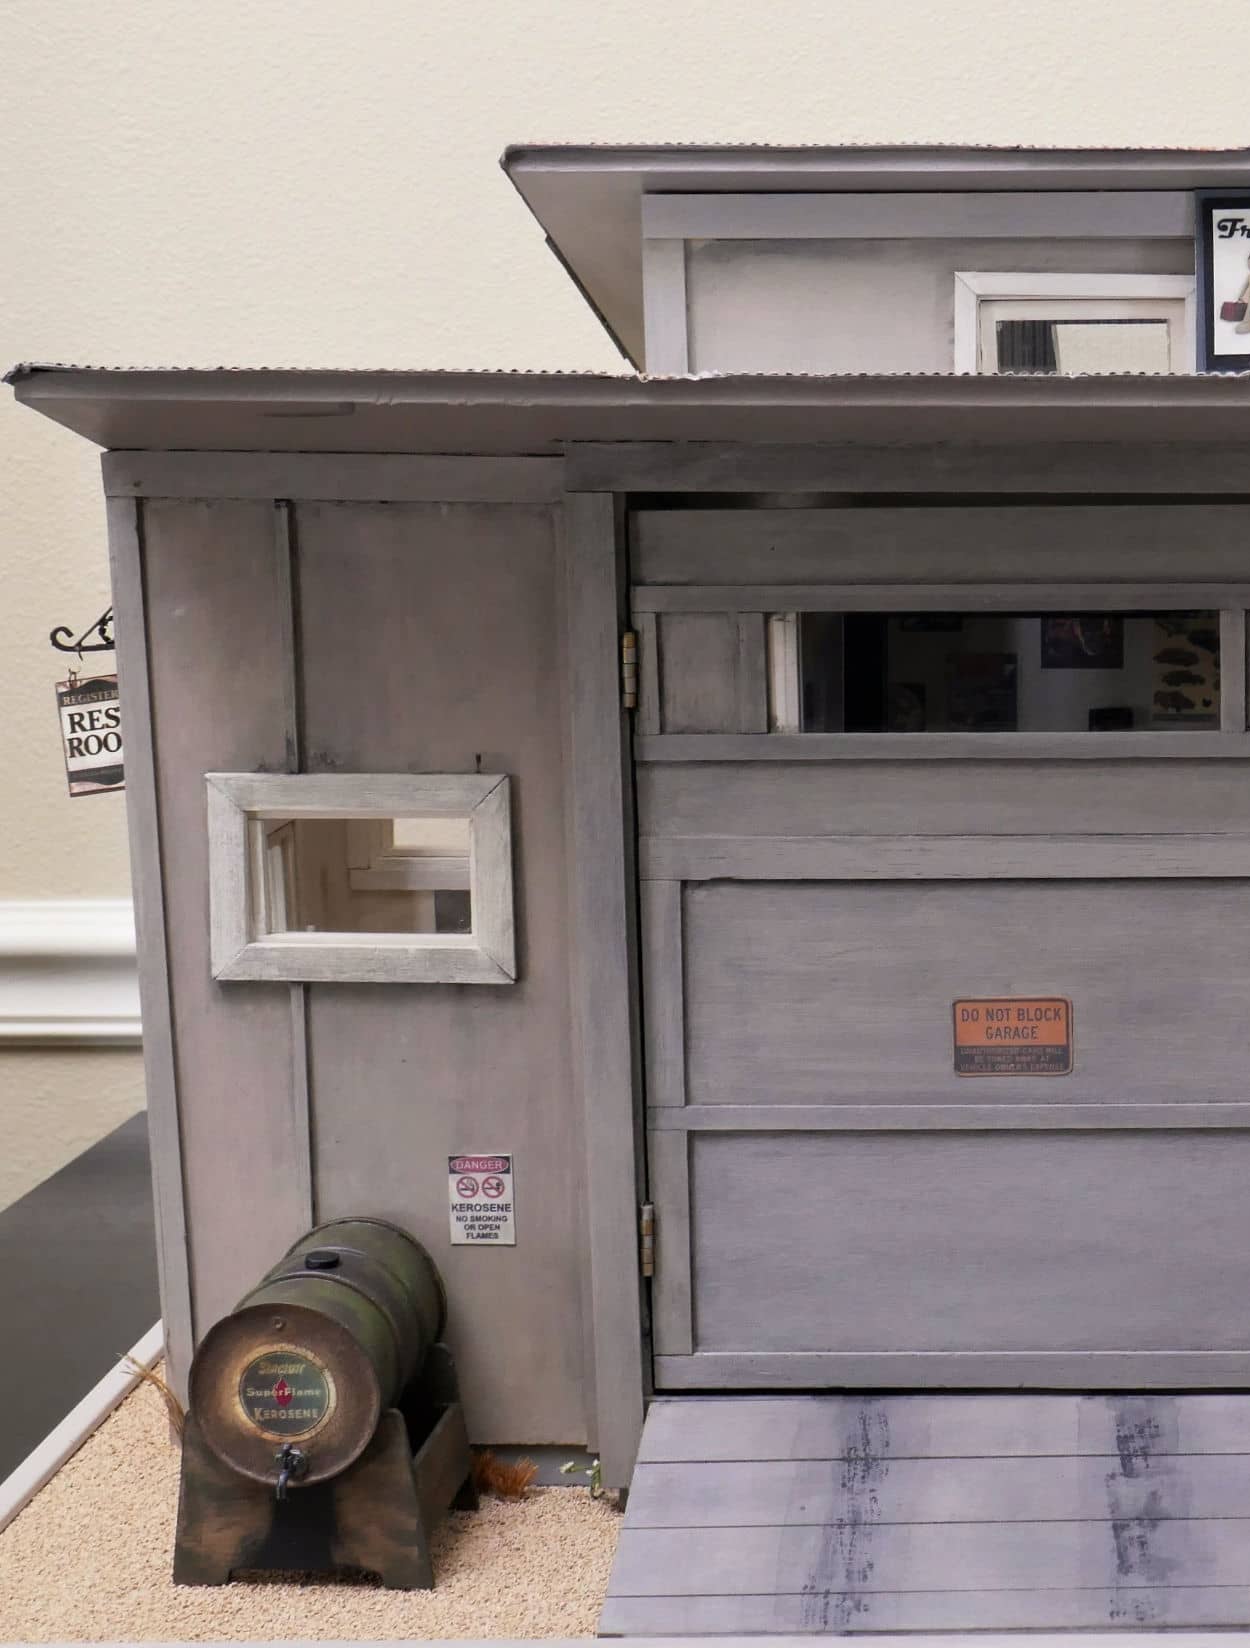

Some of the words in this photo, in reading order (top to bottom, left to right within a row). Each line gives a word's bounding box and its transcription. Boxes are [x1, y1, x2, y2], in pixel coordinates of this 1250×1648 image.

[63, 690, 119, 705] REGISTER
[67, 706, 120, 734] RES
[67, 732, 122, 758] ROO
[961, 1008, 979, 1022] DO
[985, 1008, 1011, 1021] NOT
[1016, 1007, 1061, 1021] BLOCK
[985, 1025, 1040, 1040] GARAGE
[455, 1160, 502, 1169] DANGER
[451, 1203, 512, 1212] KEROSENE
[464, 1223, 476, 1231] OR
[478, 1223, 500, 1231] OPEN
